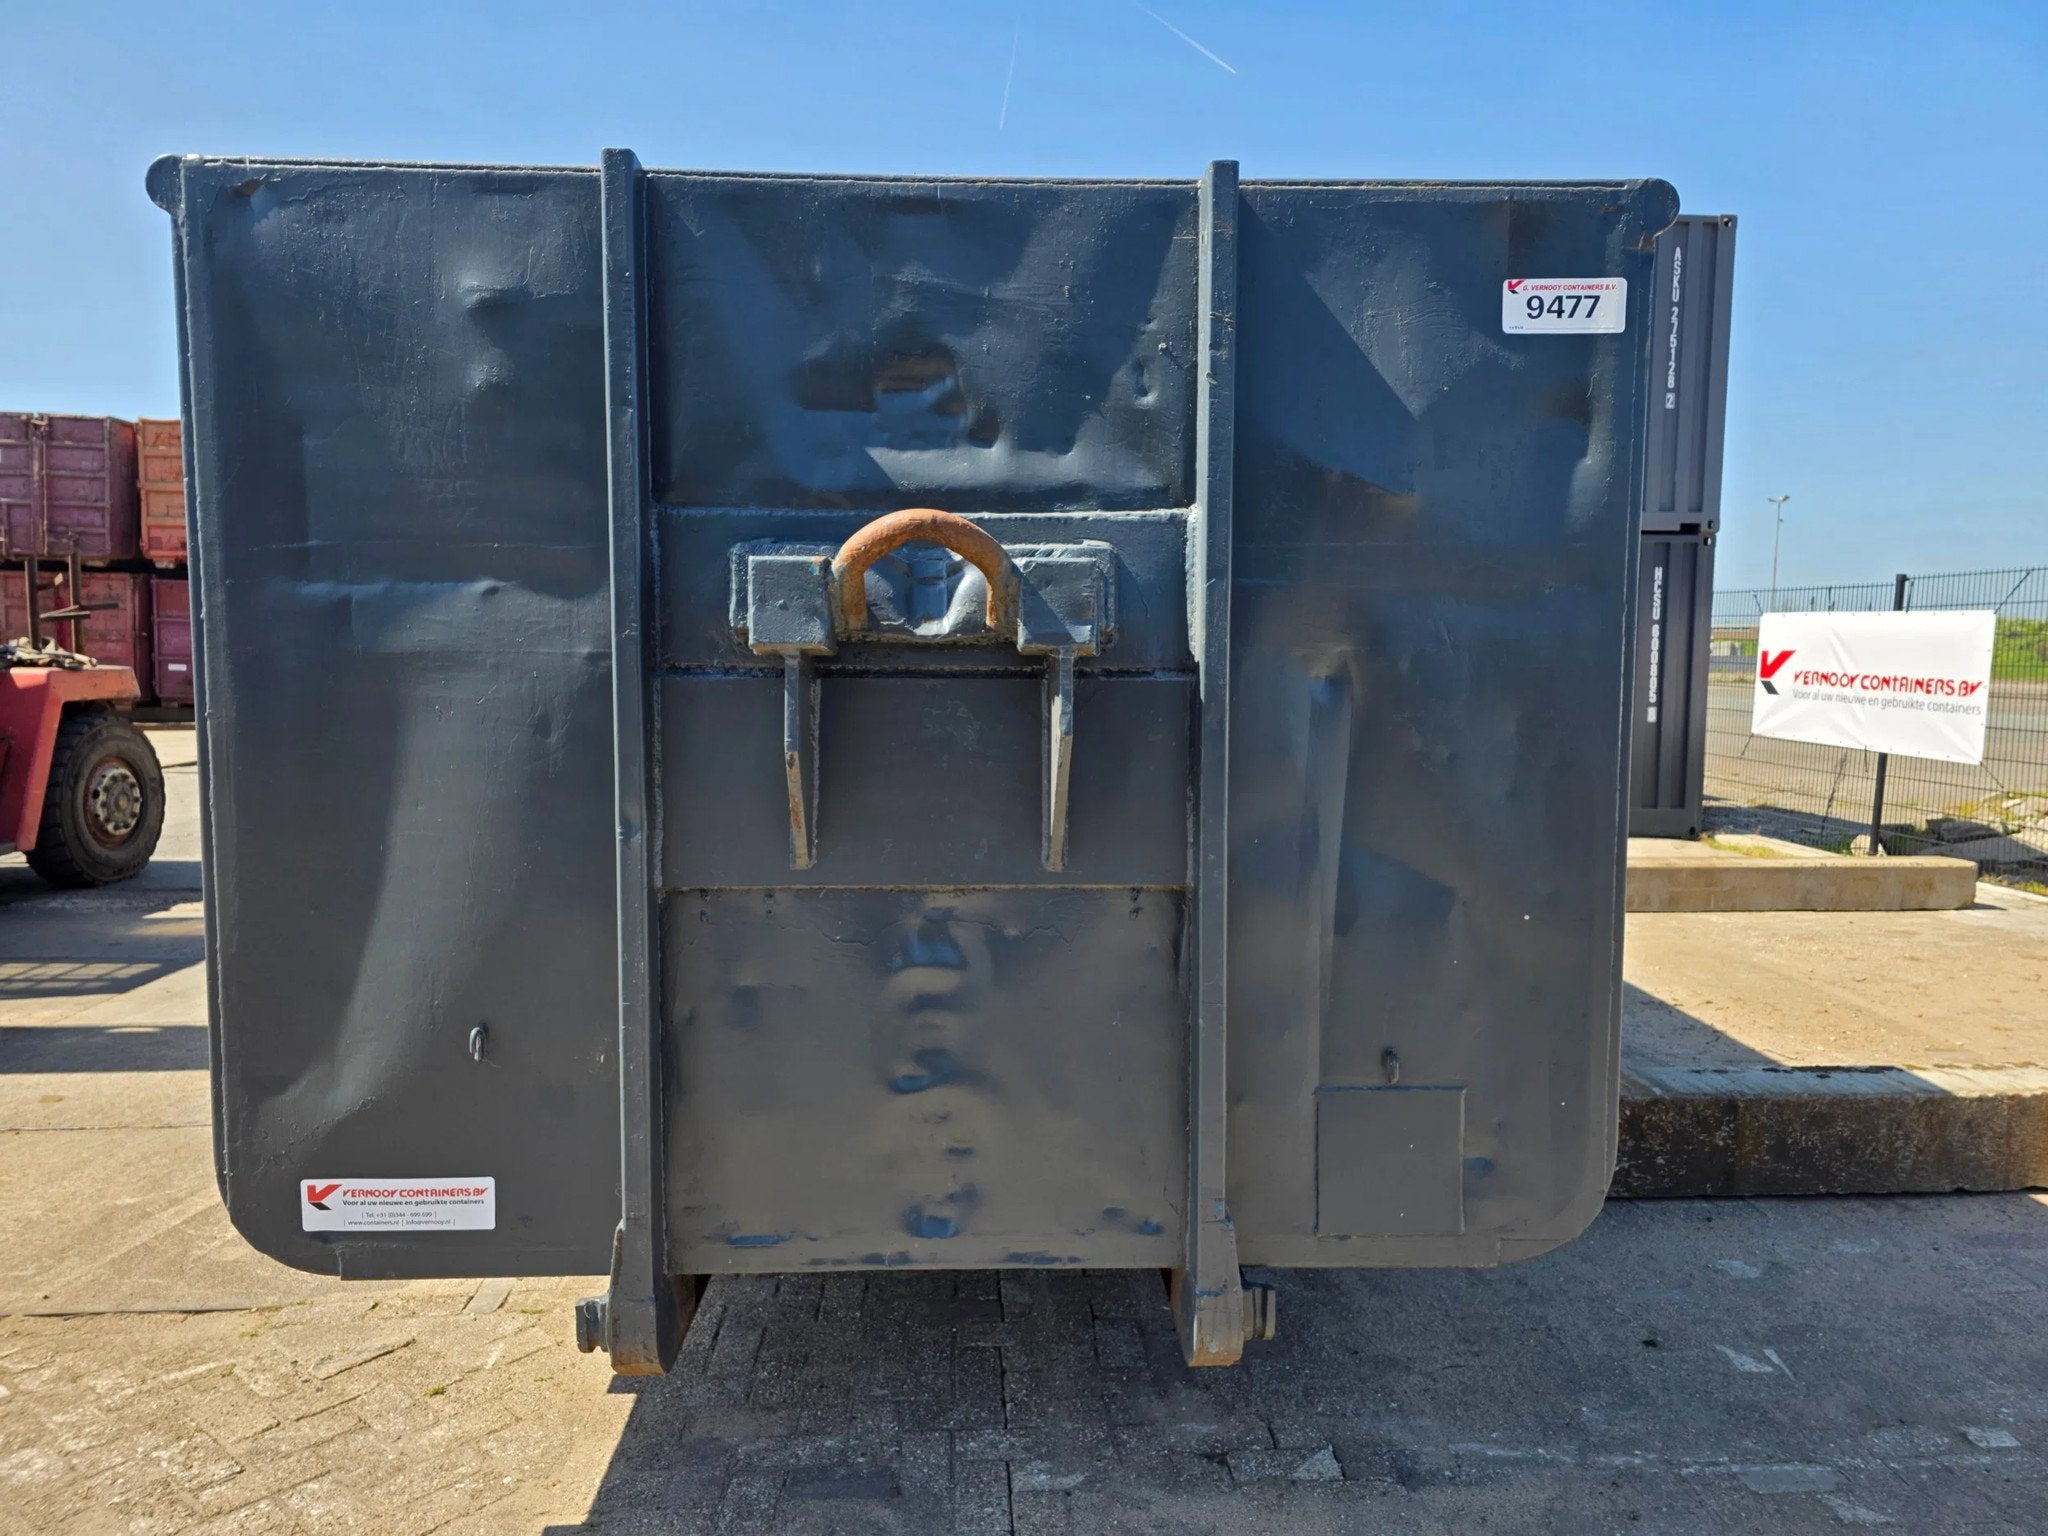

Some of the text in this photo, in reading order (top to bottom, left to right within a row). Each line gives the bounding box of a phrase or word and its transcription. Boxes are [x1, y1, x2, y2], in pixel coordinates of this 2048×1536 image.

[1672, 247, 1682, 302] ASKU
[1526, 295, 1601, 319] 9477
[1667, 306, 1679, 388] 275128
[1793, 670, 1983, 697] VERNOOY CONTAINERS BV
[1792, 689, 1981, 715] Voor al uw nieuwe en gebruikte containers
[342, 1187, 489, 1198] VERNOOY CONTAINERS BV
